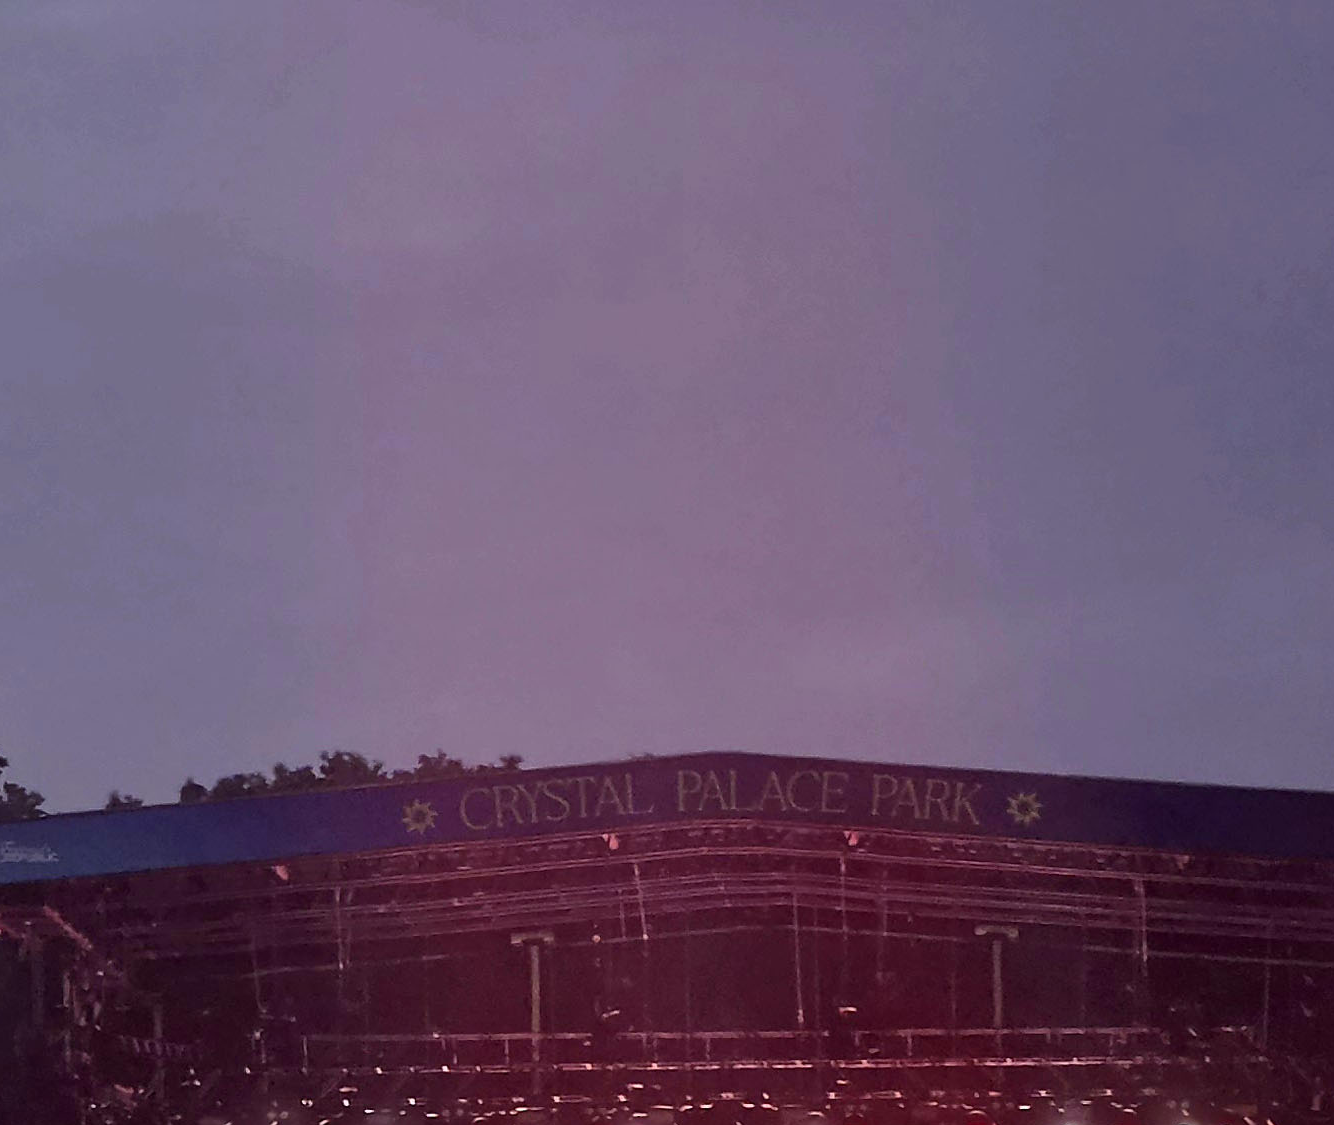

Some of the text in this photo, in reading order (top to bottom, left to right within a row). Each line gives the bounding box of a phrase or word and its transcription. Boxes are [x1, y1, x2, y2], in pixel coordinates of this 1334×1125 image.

[459, 769, 984, 831] CRYSTAL PALACE PARK
